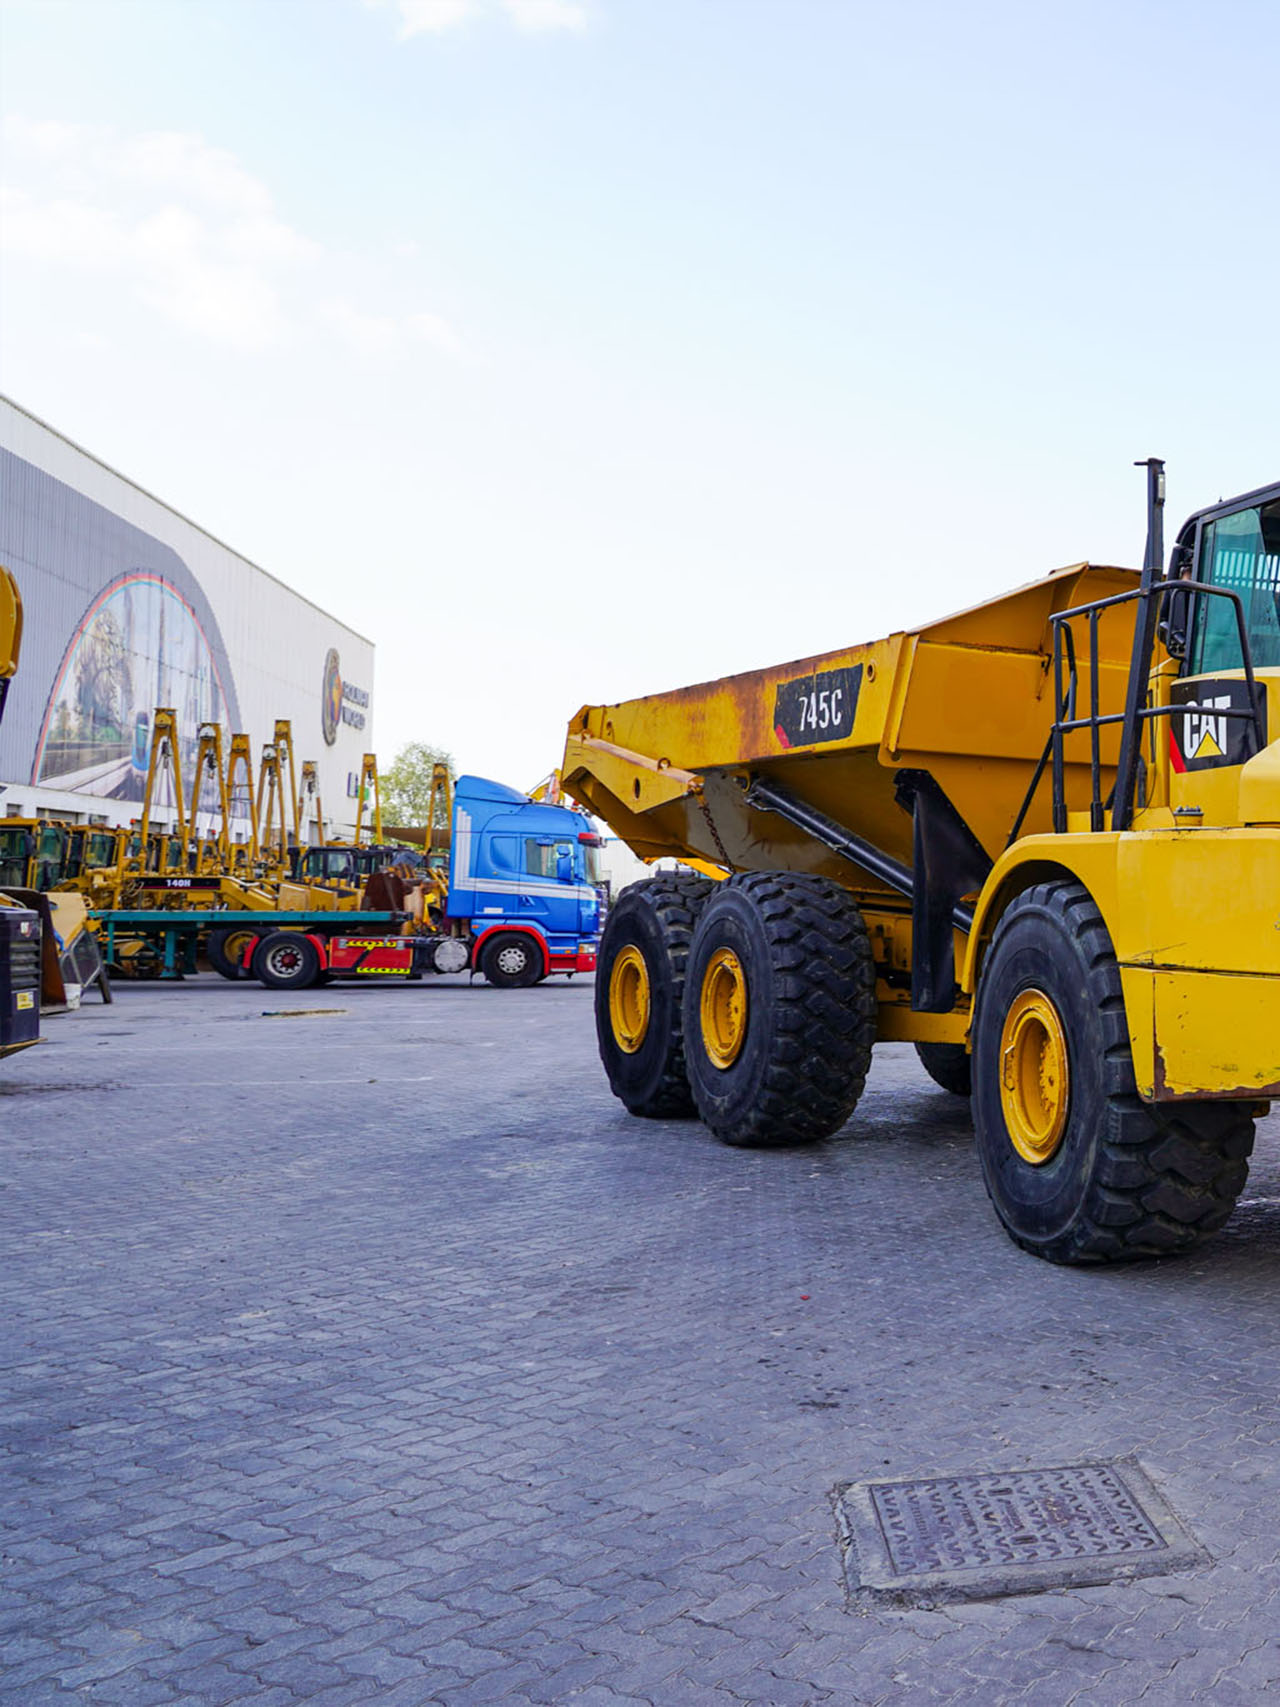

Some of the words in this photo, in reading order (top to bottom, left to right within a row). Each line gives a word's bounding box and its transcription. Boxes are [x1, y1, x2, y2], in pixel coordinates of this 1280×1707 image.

[798, 689, 843, 732] 745C
[1184, 695, 1231, 759] CAT
[166, 879, 191, 887] 140H
